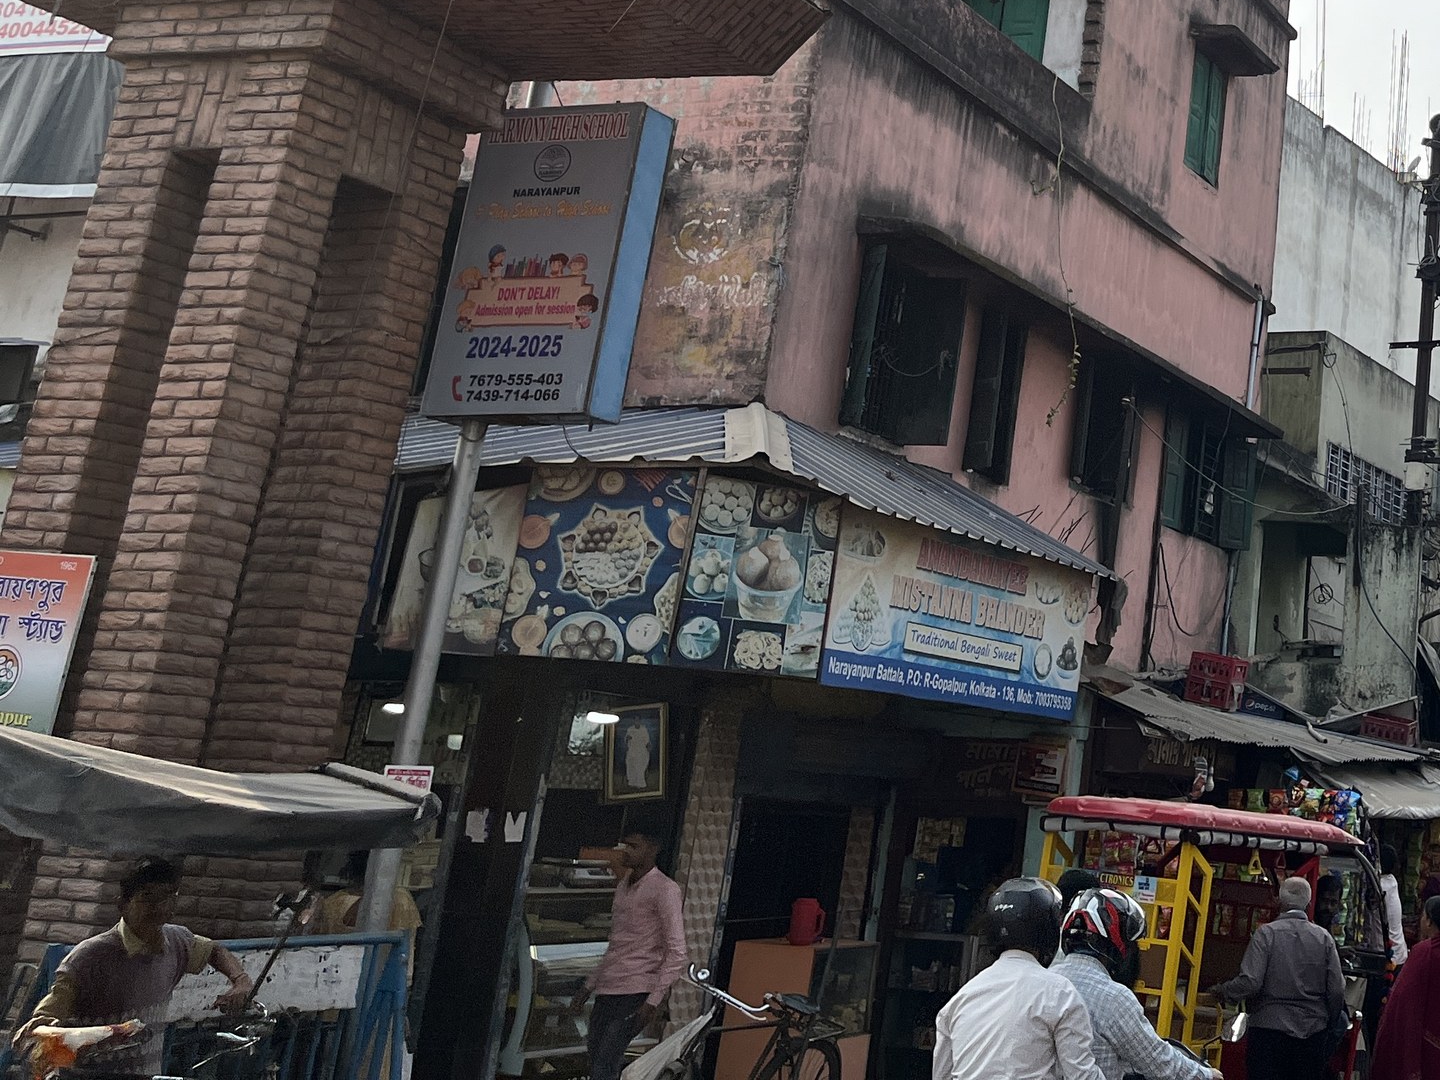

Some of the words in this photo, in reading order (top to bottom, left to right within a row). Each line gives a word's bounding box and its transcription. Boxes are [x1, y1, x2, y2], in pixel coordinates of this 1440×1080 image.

[549, 115, 582, 140] HIGH
[581, 113, 629, 139] SCHOOL
[513, 186, 581, 198] NARAYANPUR
[497, 286, 526, 302] DON'T
[527, 284, 560, 301] DELAY!
[475, 303, 513, 317] Admission
[514, 304, 533, 318] open
[534, 303, 546, 316] for
[547, 302, 576, 316] session
[465, 334, 564, 360] 2024-2025
[469, 373, 564, 387] 7679-555-403
[466, 389, 560, 403] 7439-714-066
[889, 574, 973, 624] MISTANNA
[975, 594, 1046, 640] BHANDER
[911, 629, 959, 652] Traditional
[960, 640, 991, 661] Bengali
[992, 647, 1017, 663] Sweet
[828, 656, 875, 684] Narayanpur
[923, 672, 967, 697] R-Gopalpur,
[969, 680, 996, 699] Kolkata
[1016, 688, 1034, 704] Mob:
[1254, 701, 1276, 712] pepsi
[1098, 872, 1134, 887] CTRONICS
